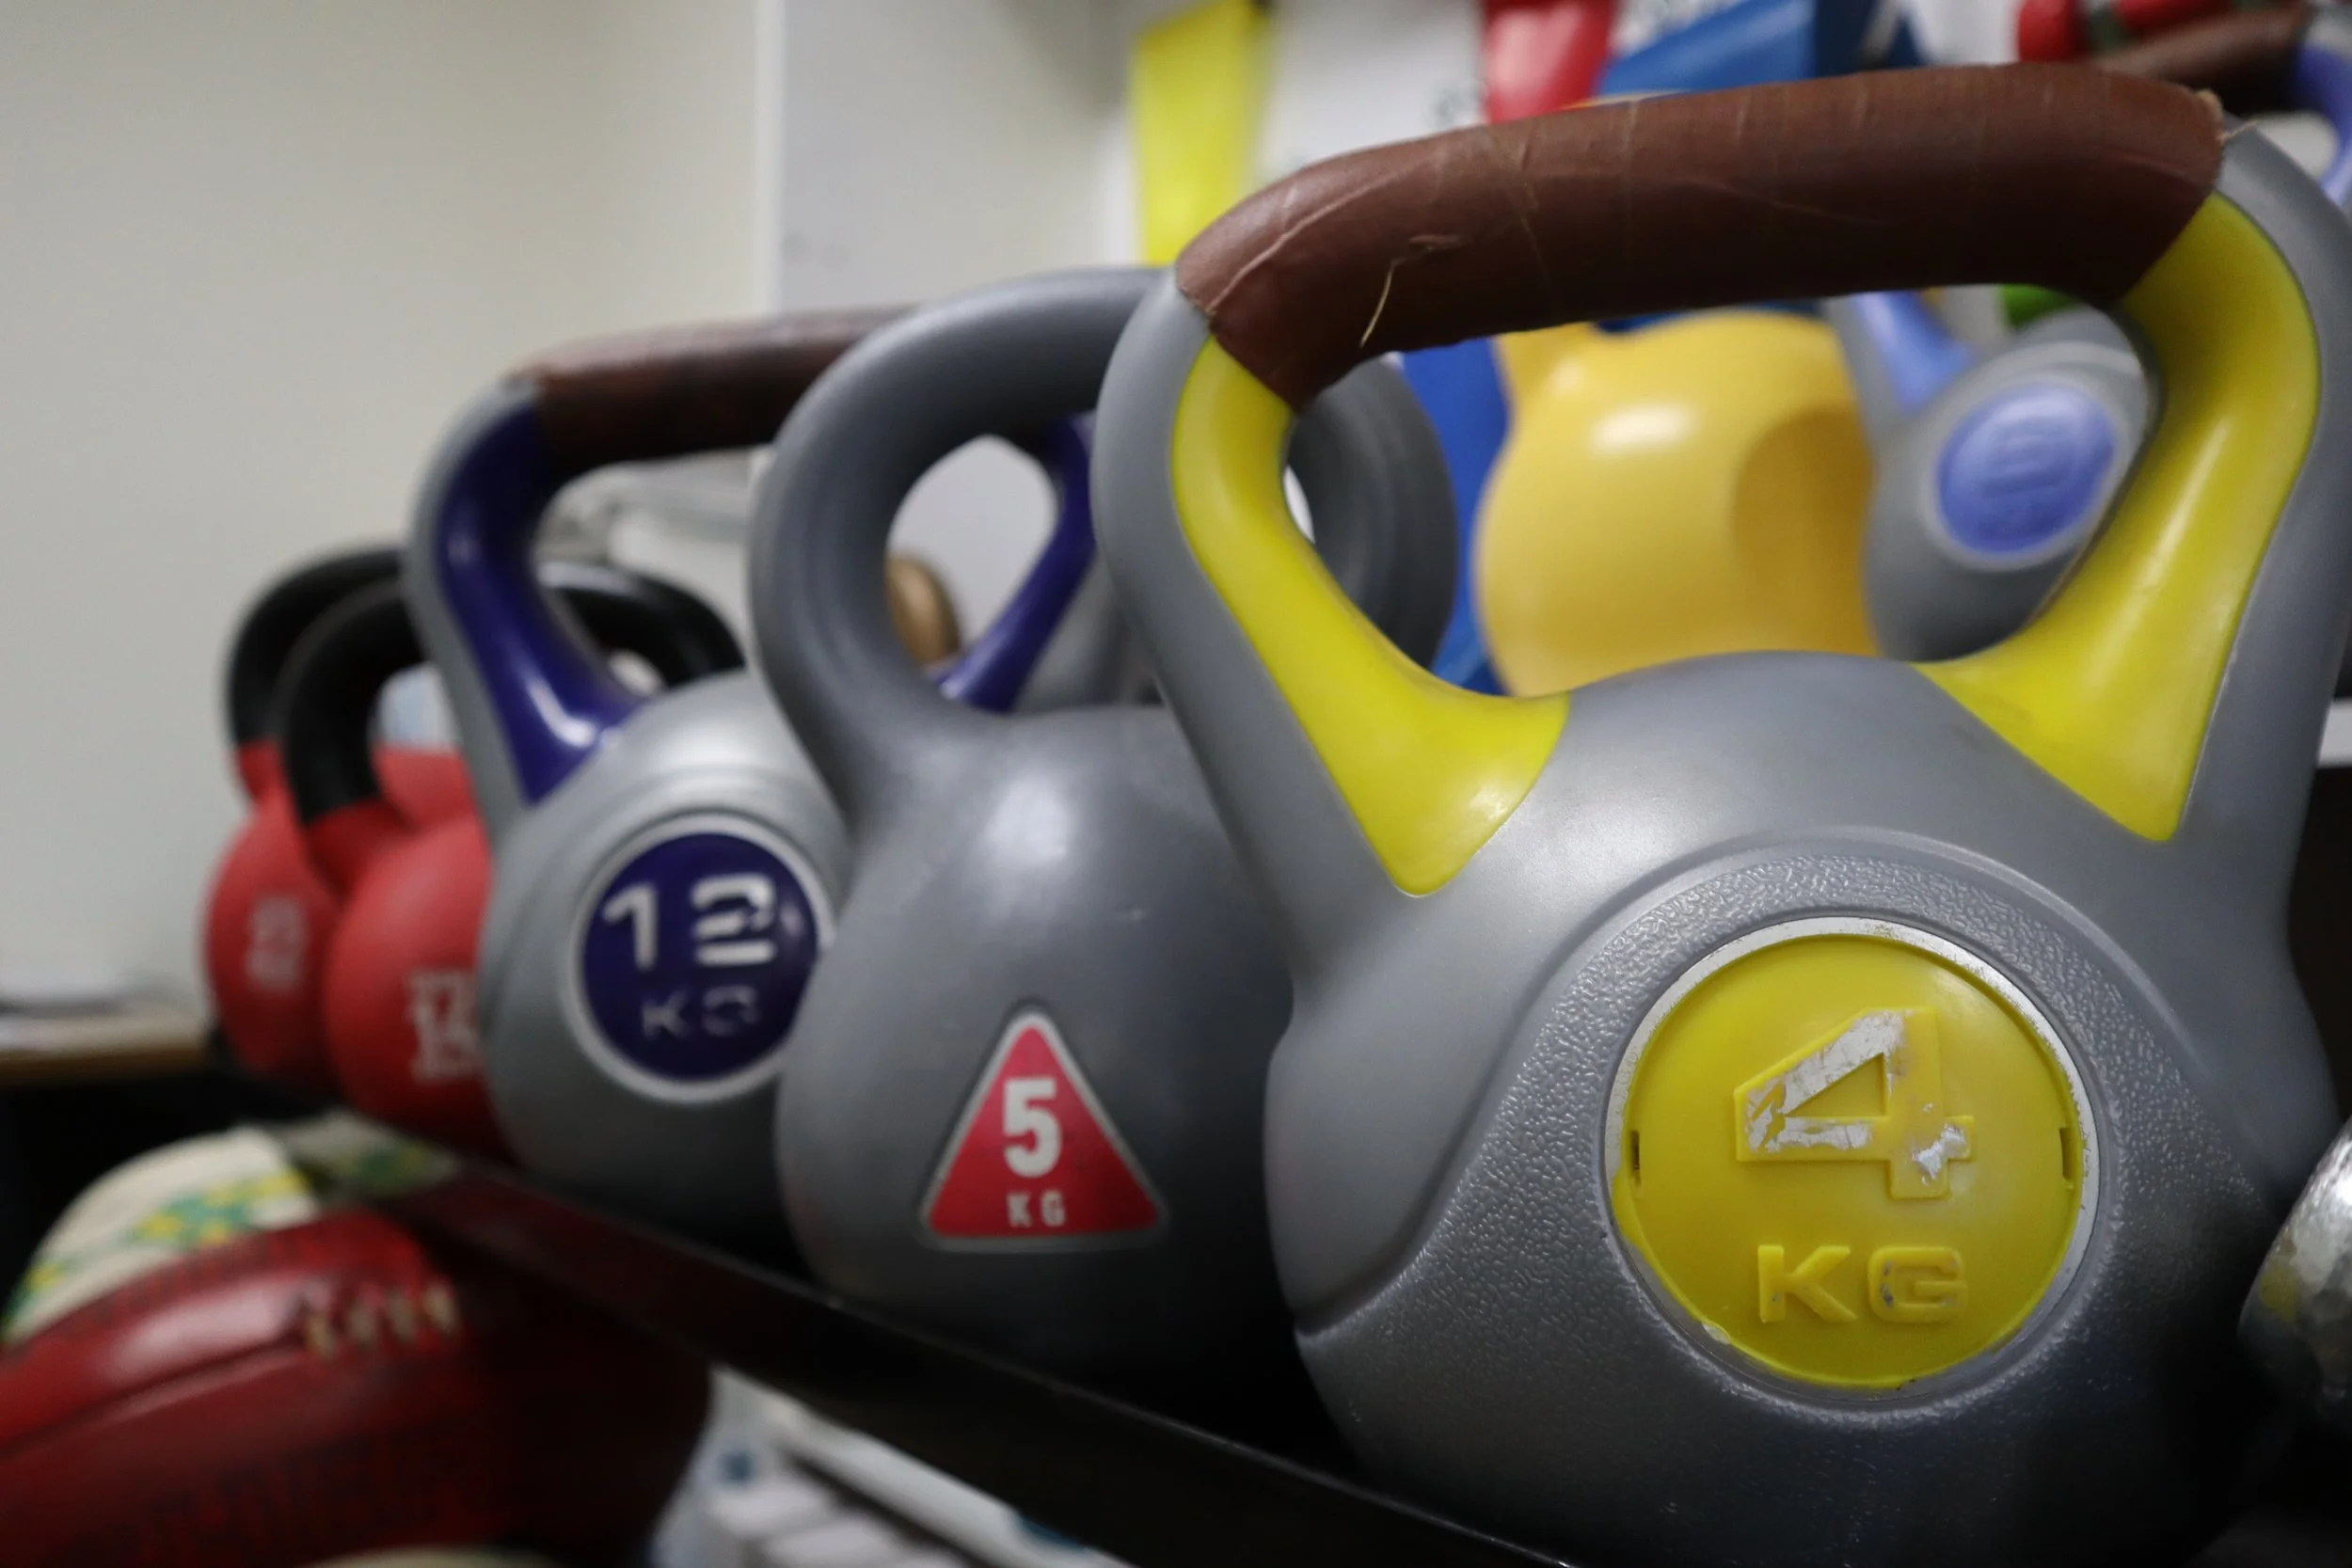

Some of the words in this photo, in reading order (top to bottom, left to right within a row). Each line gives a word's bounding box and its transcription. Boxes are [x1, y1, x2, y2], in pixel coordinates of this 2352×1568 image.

[599, 872, 778, 971] 12
[1003, 1077, 1062, 1179] 5
[1734, 1006, 1974, 1199] 4
[1006, 1190, 1066, 1227] KG
[1757, 1243, 1968, 1324] KG
